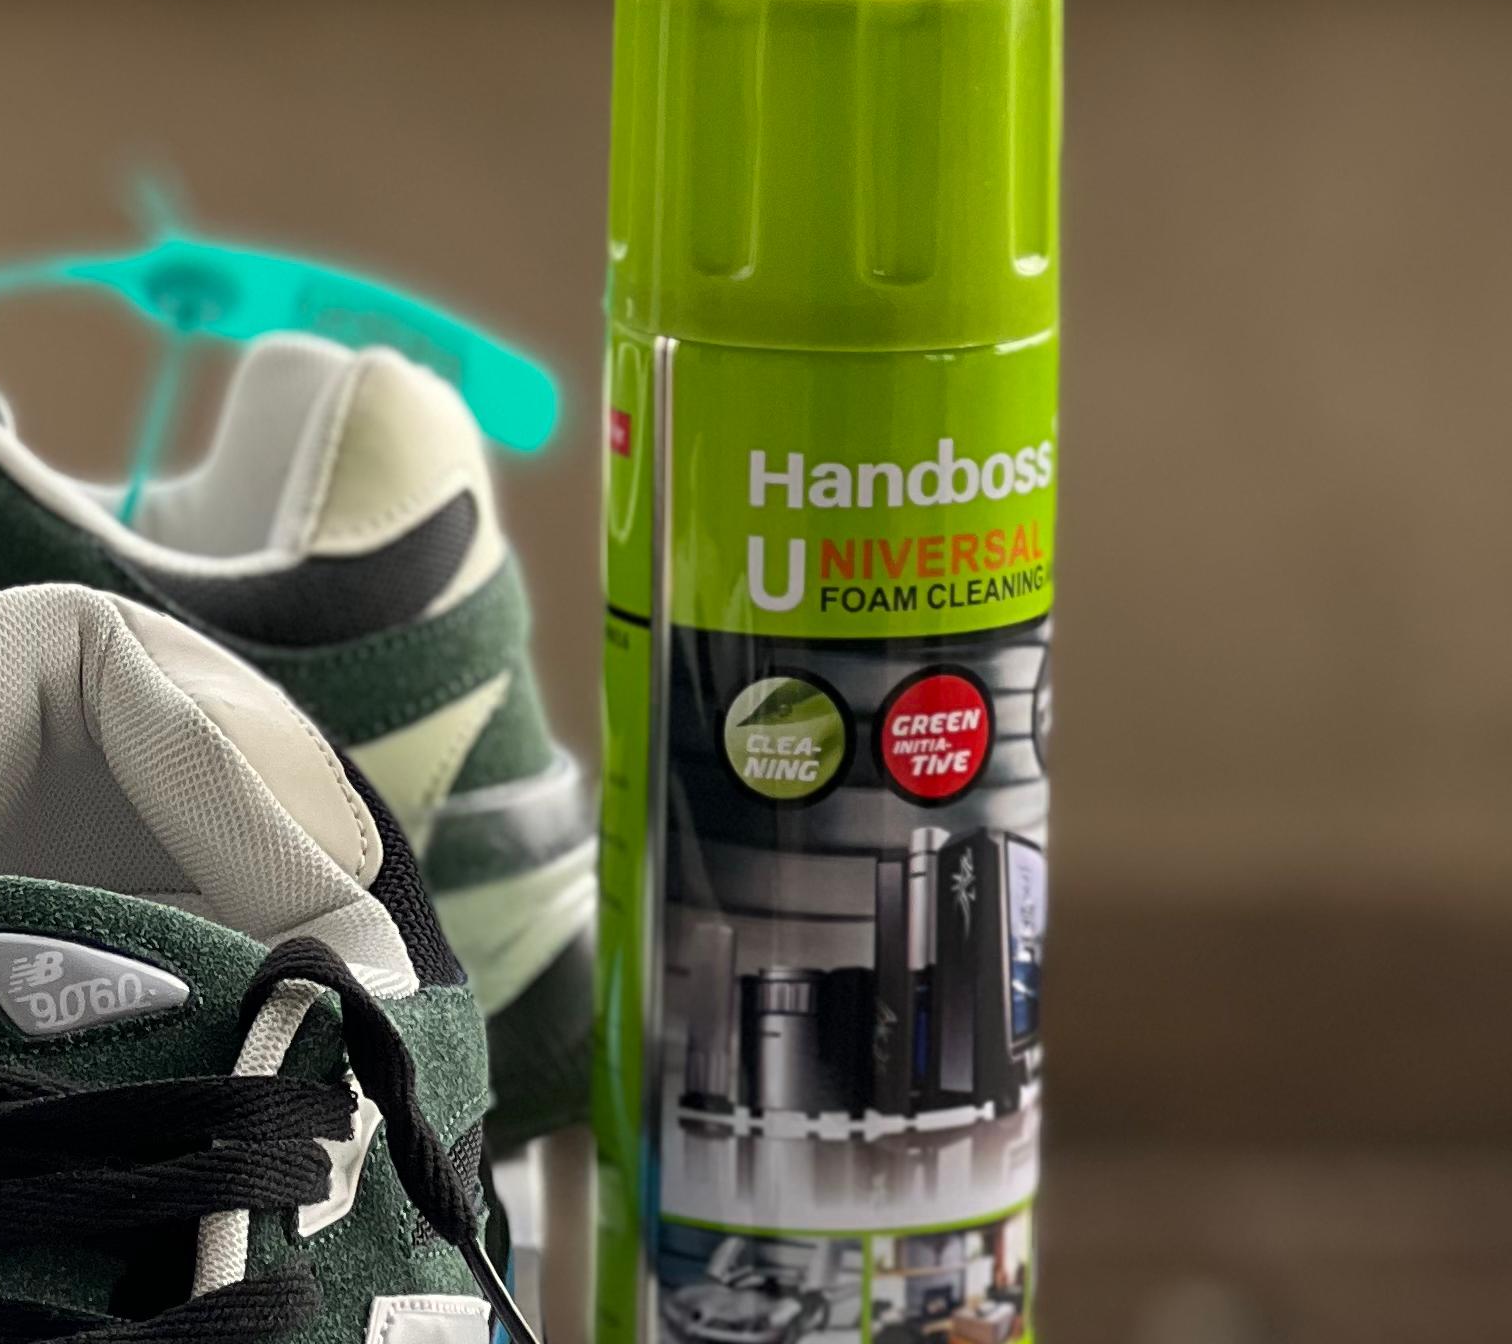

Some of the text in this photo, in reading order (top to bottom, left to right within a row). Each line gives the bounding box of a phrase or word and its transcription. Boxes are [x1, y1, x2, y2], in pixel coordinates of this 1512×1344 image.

[748, 438, 1053, 509] Handboss
[820, 585, 918, 613] FOAM
[926, 565, 1044, 610] CLEANING
[891, 708, 981, 736] GREEN
[744, 756, 820, 783] NING
[911, 750, 971, 776] TIVE
[15, 972, 145, 1026] 9060
